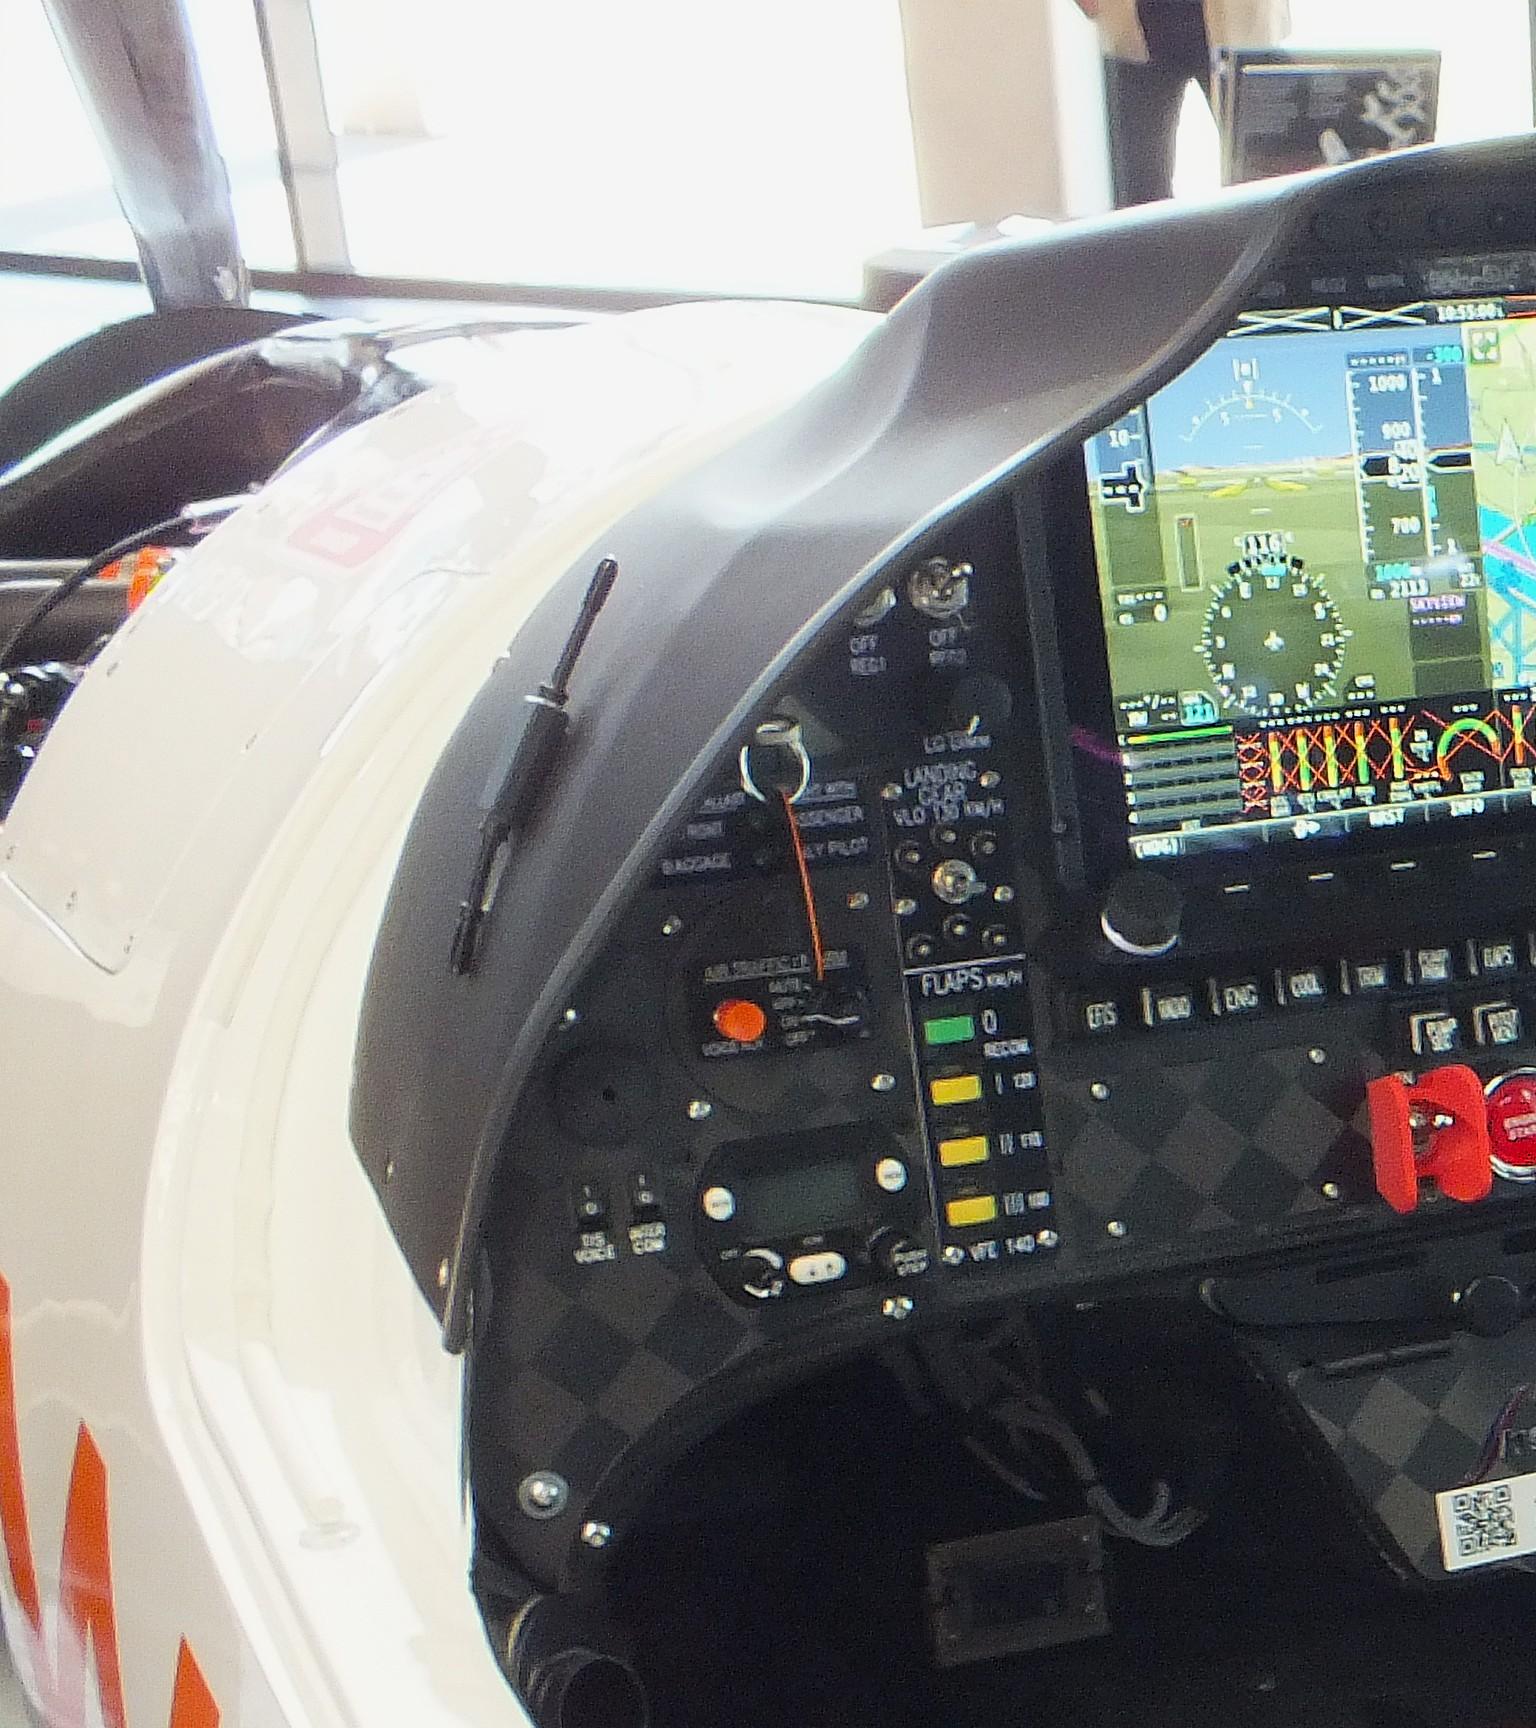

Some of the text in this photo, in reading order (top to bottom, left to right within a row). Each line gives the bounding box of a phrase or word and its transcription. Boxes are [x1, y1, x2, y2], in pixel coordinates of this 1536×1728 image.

[904, 762, 978, 790] LANDING
[917, 782, 969, 806] GEAR
[894, 804, 928, 827] VLO
[920, 968, 985, 998] FLAPS
[1223, 983, 1259, 1012] ENG
